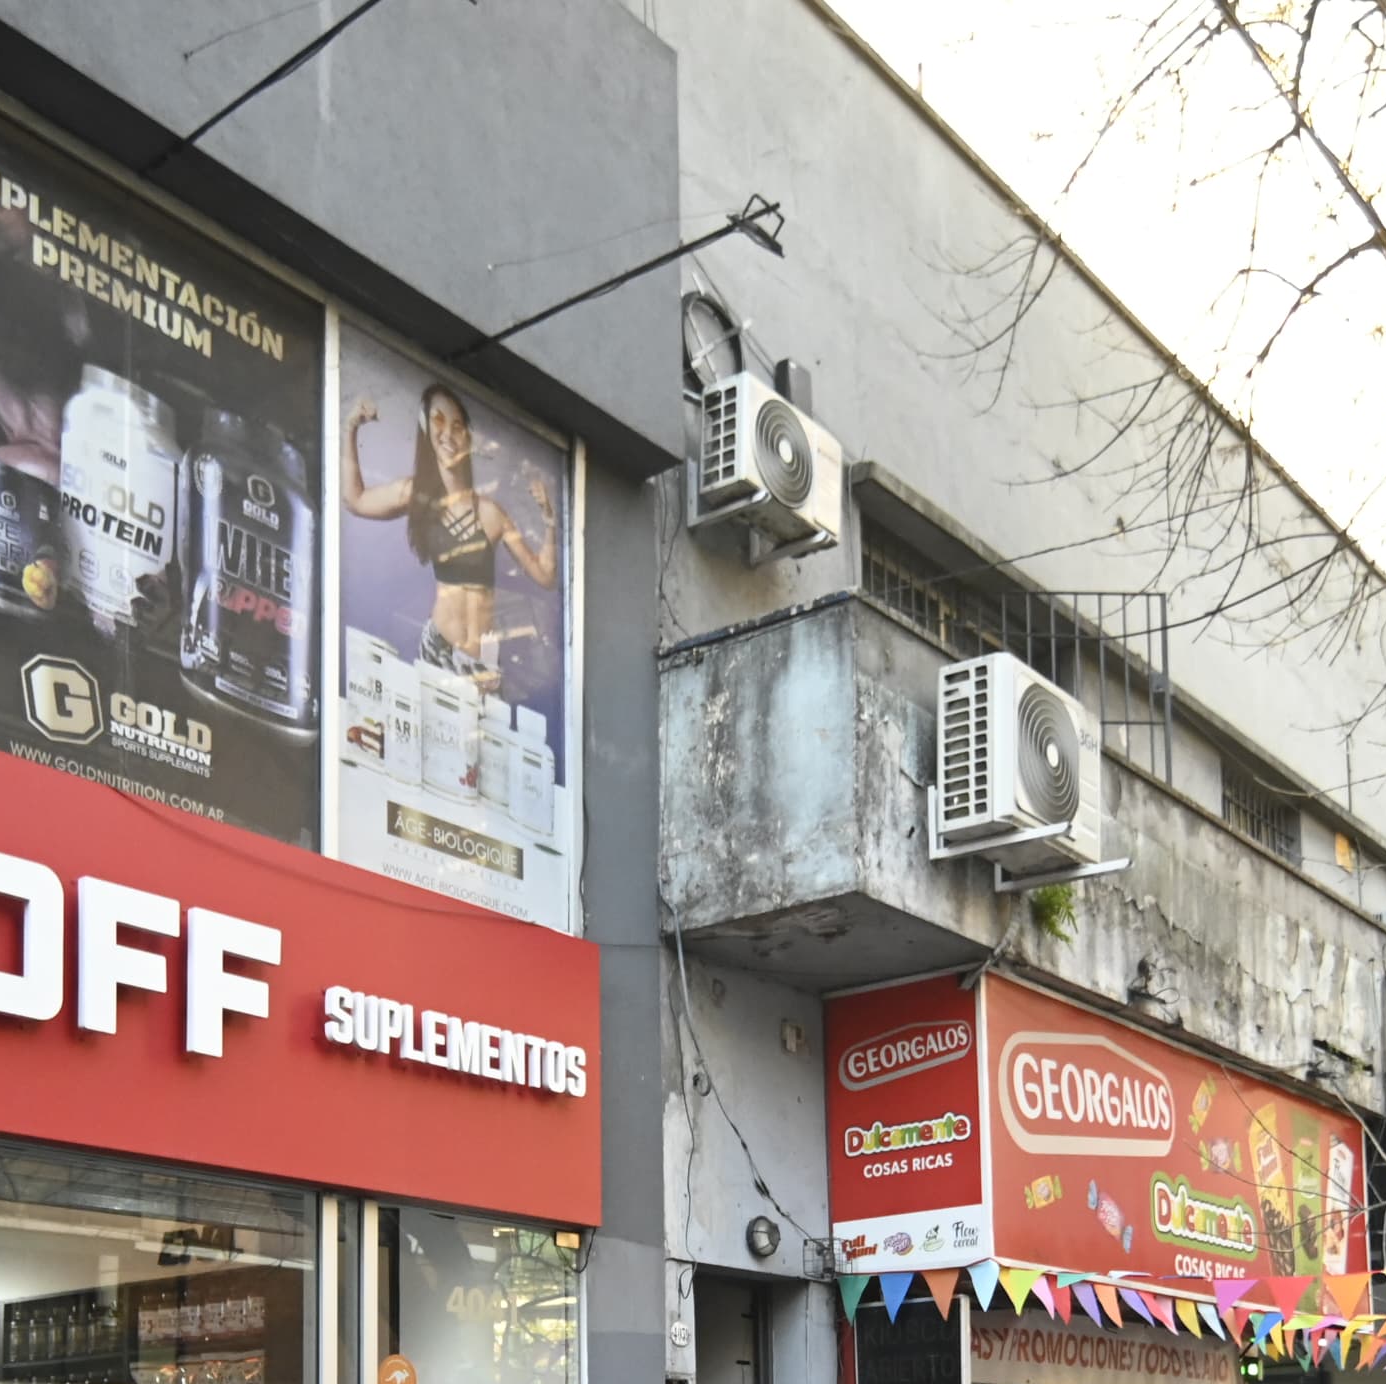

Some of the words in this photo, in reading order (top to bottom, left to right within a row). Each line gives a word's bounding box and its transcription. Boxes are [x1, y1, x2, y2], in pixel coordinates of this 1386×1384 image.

[32, 234, 212, 359] PREMIUM
[63, 492, 163, 556] PROTEIN
[242, 499, 280, 531] GOLD
[111, 691, 213, 753] GOLD
[111, 719, 212, 766] NUTRITION
[112, 736, 148, 758] SPORTS
[148, 747, 212, 779] SUPPLEMENTS
[324, 985, 588, 1099] SUPLEMENTOS
[847, 1024, 968, 1079] GEORGALOS
[1013, 1052, 1171, 1131] GEORGALOS
[863, 1159, 909, 1179] COSAS
[912, 1152, 953, 1173] RICAS
[1174, 1253, 1213, 1282] COSAS
[1136, 1341, 1181, 1377] TODO
